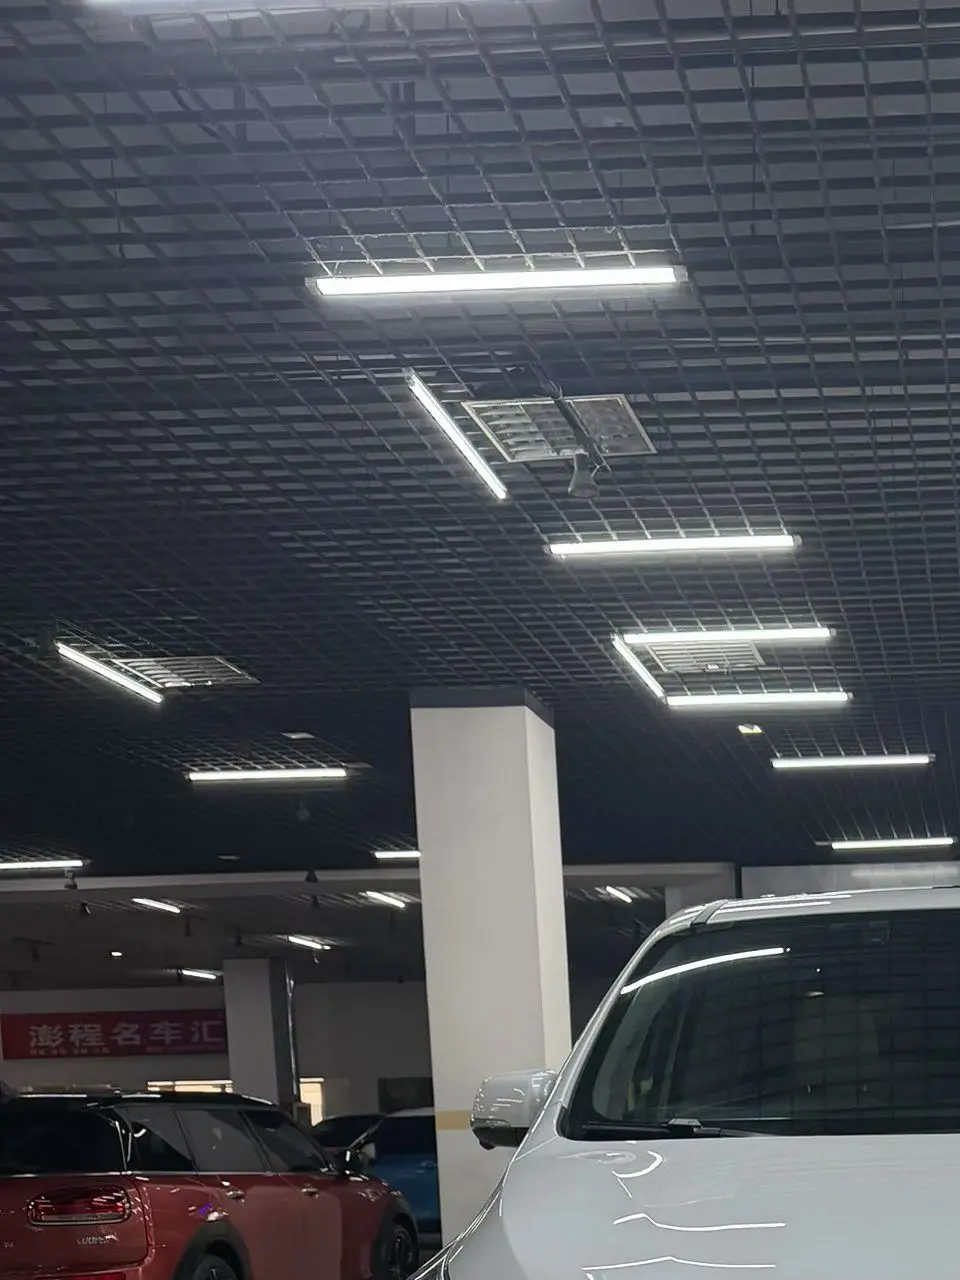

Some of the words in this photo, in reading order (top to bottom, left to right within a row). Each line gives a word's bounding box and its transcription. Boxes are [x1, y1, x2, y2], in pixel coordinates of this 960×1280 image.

[28, 1018, 225, 1047] 澎程名车汇
